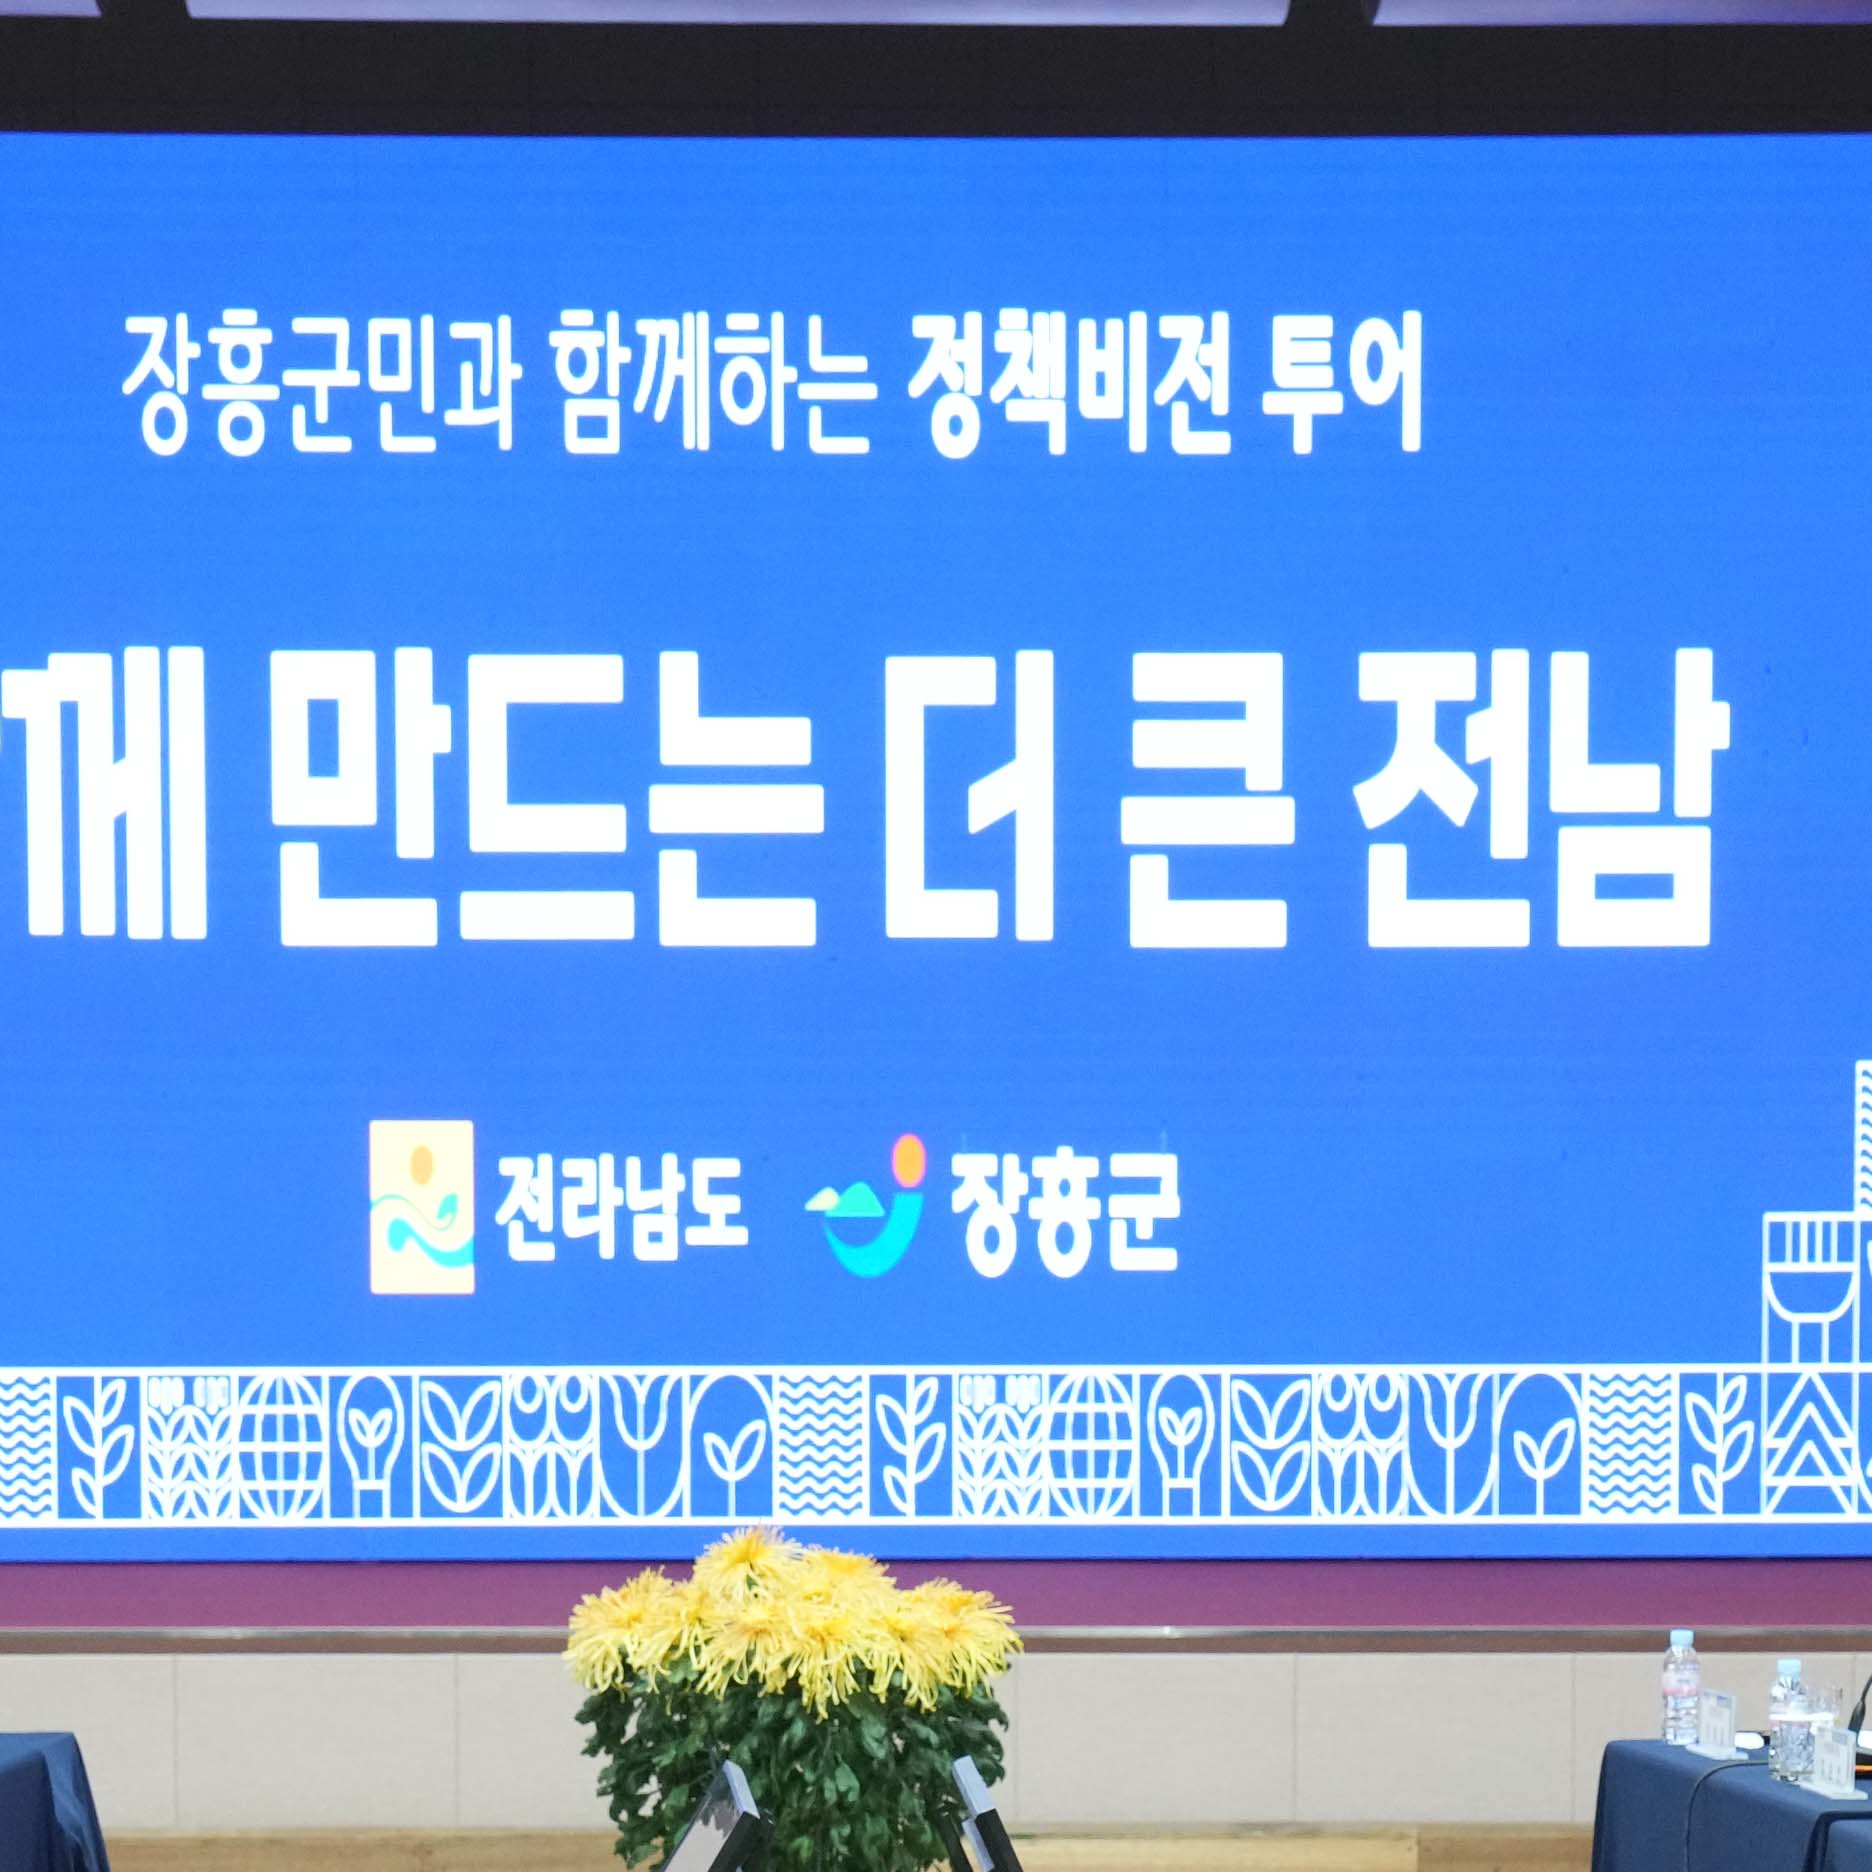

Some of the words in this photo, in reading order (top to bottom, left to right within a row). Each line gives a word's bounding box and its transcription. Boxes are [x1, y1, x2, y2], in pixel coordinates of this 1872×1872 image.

[123, 310, 522, 456] 장흥군민과
[550, 310, 877, 455] 함께하는
[909, 309, 1231, 459] 정책비전
[1263, 311, 1422, 454] 투어
[271, 647, 824, 947] 만드는
[885, 650, 1054, 941] 더
[1121, 652, 1296, 948] 큰
[1354, 648, 1730, 948] 전남
[496, 1152, 749, 1263] 전라남도
[952, 1147, 1181, 1278] 장흥군
